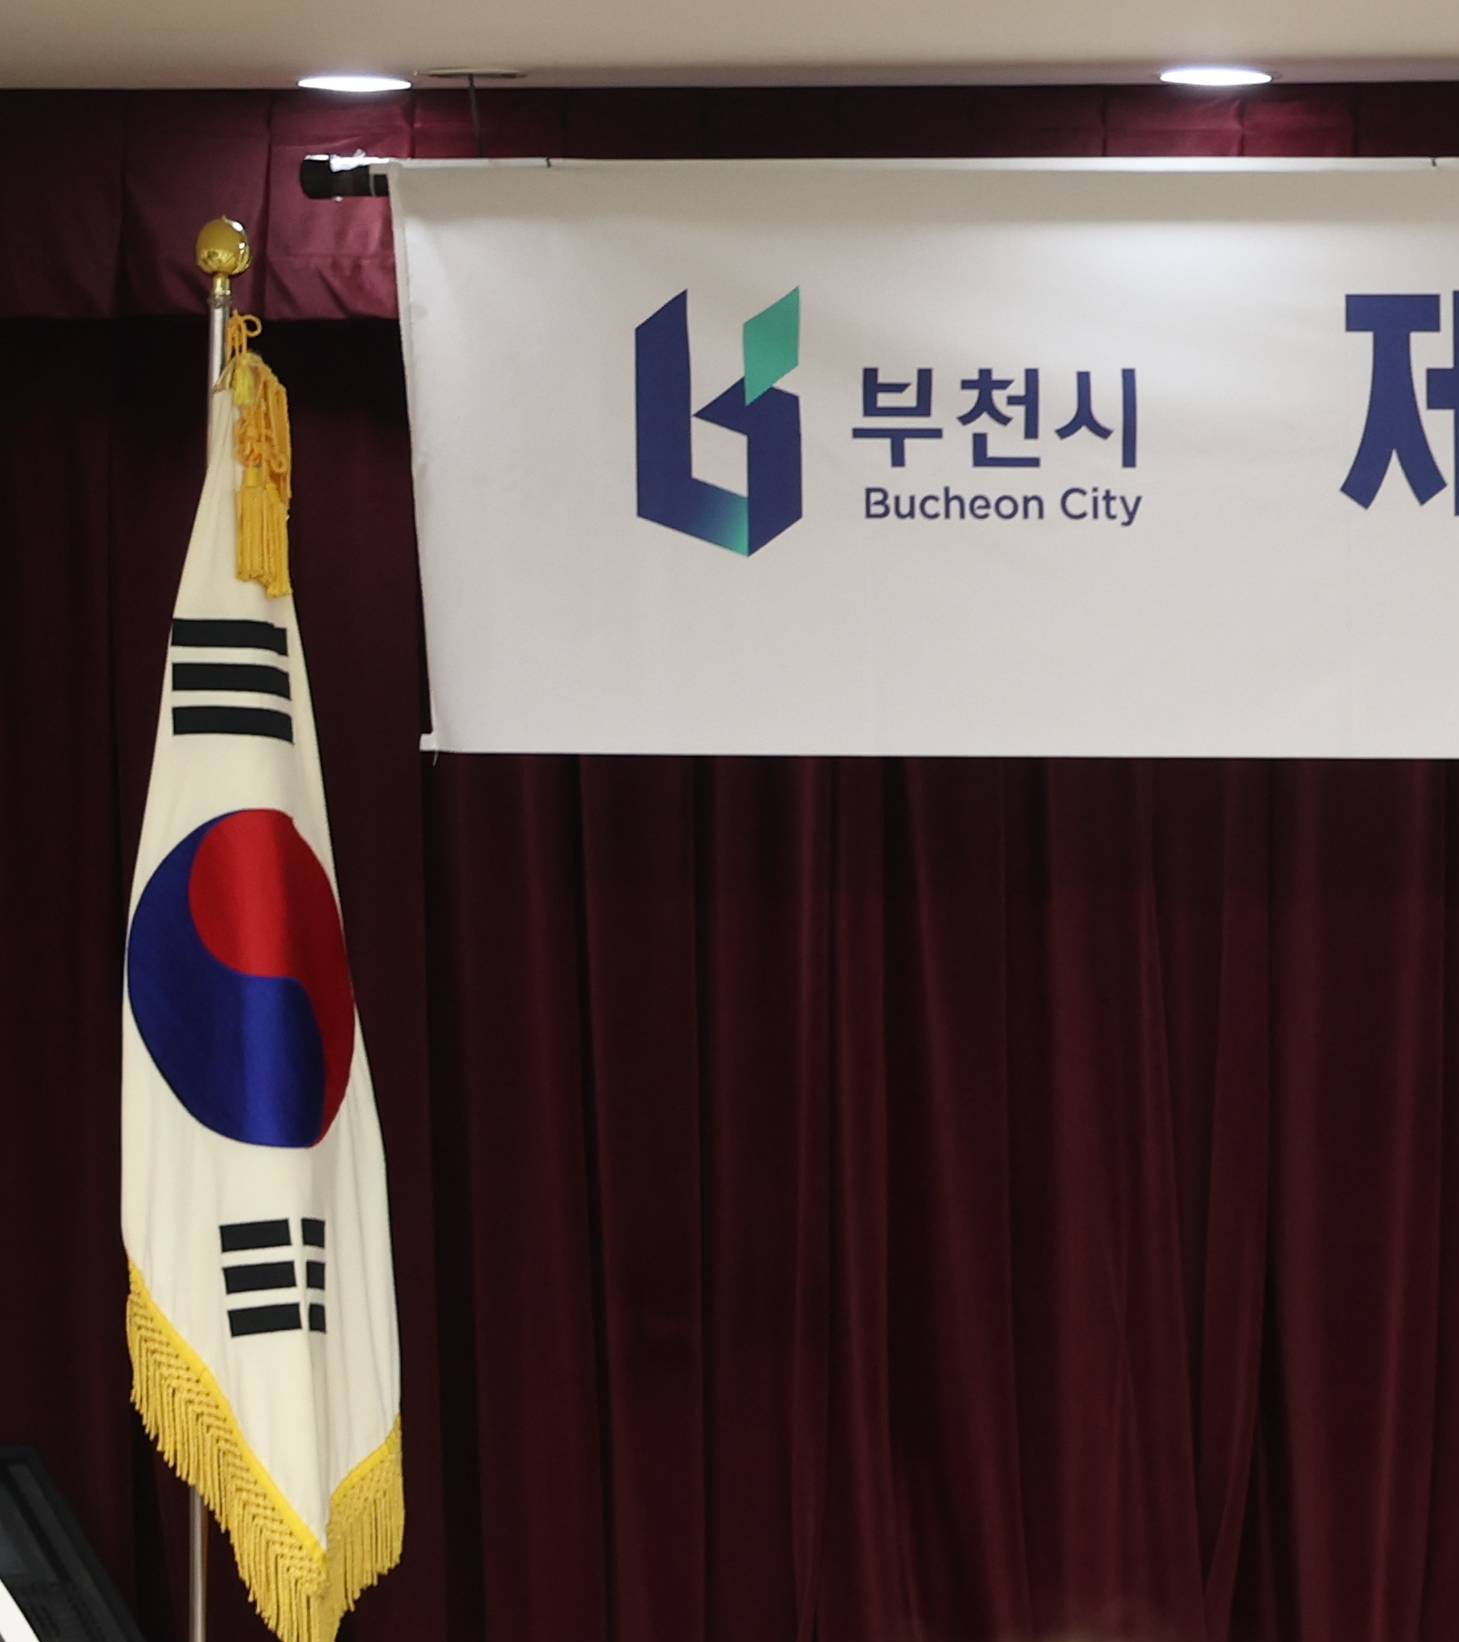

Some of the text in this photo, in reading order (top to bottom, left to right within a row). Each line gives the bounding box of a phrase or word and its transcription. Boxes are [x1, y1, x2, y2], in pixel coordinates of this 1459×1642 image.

[850, 366, 1137, 469] 부천시
[863, 485, 1142, 527] Bucheon City
